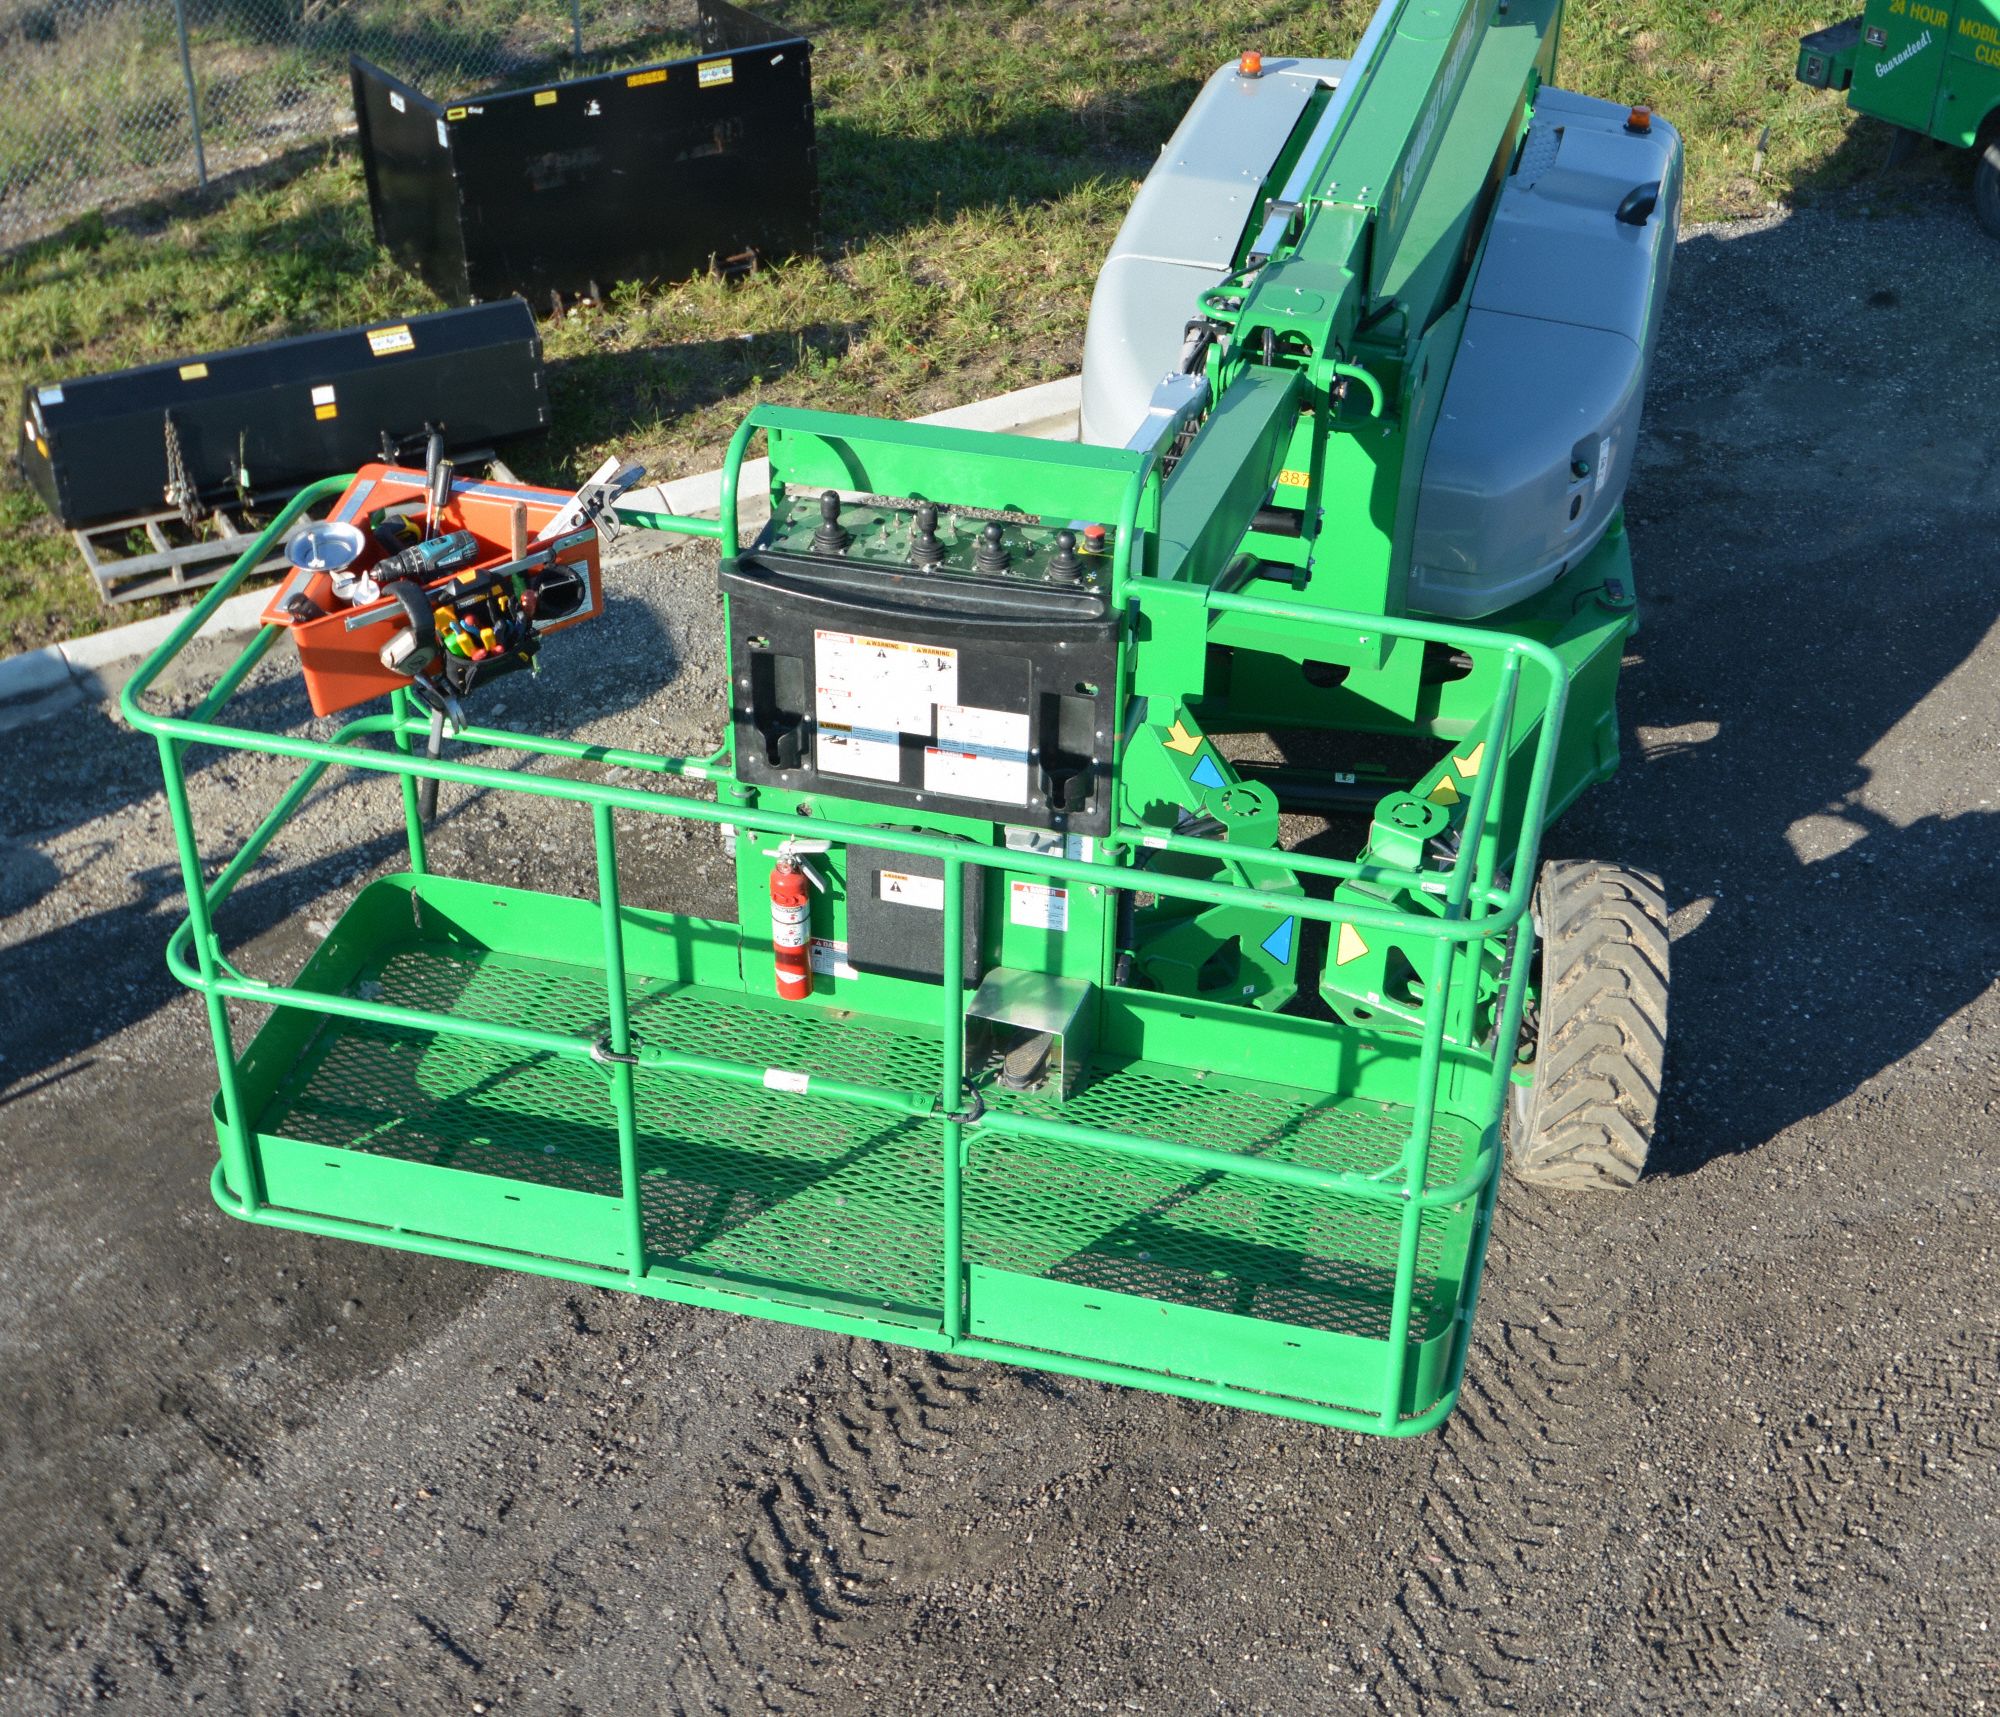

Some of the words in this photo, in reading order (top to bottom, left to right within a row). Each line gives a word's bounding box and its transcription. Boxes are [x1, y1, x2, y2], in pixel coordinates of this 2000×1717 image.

[1910, 3, 1948, 28] HOUR
[1875, 30, 1932, 77] Guaranteed!
[1280, 470, 1310, 486] 387
[872, 641, 899, 650] WARNING
[922, 648, 950, 657] WARNING
